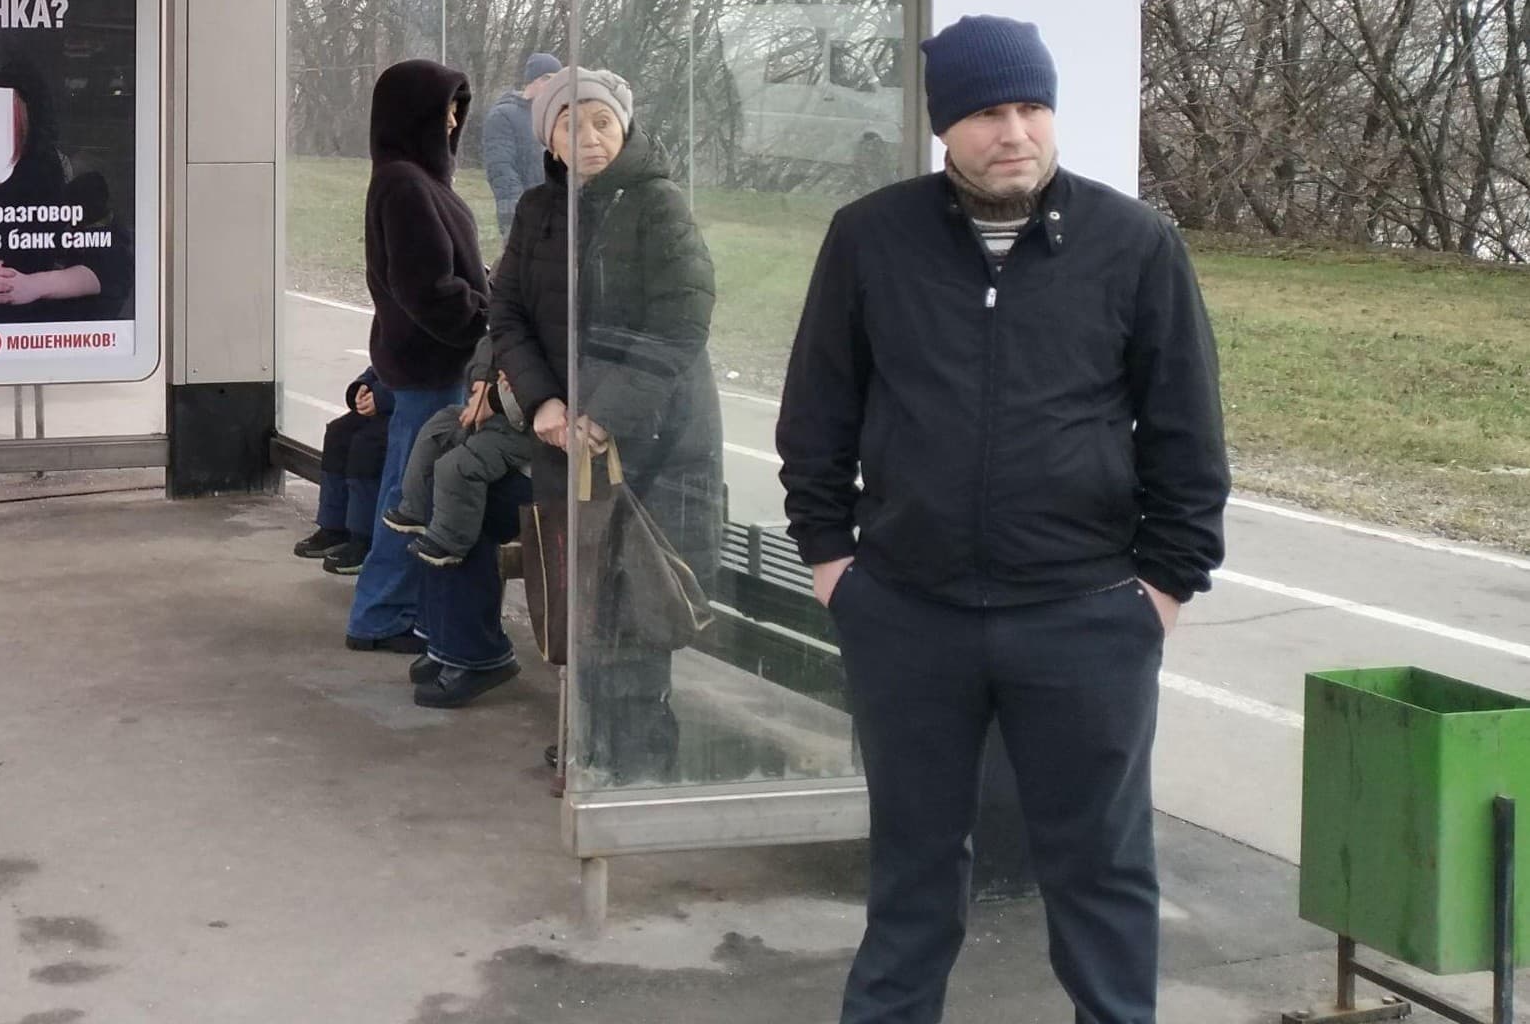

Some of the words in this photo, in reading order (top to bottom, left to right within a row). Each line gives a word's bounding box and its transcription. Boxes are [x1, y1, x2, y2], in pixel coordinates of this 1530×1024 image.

[8, 228, 56, 250] банк
[61, 230, 112, 249] сами
[6, 332, 116, 351] МОШЕННИКОВ!
